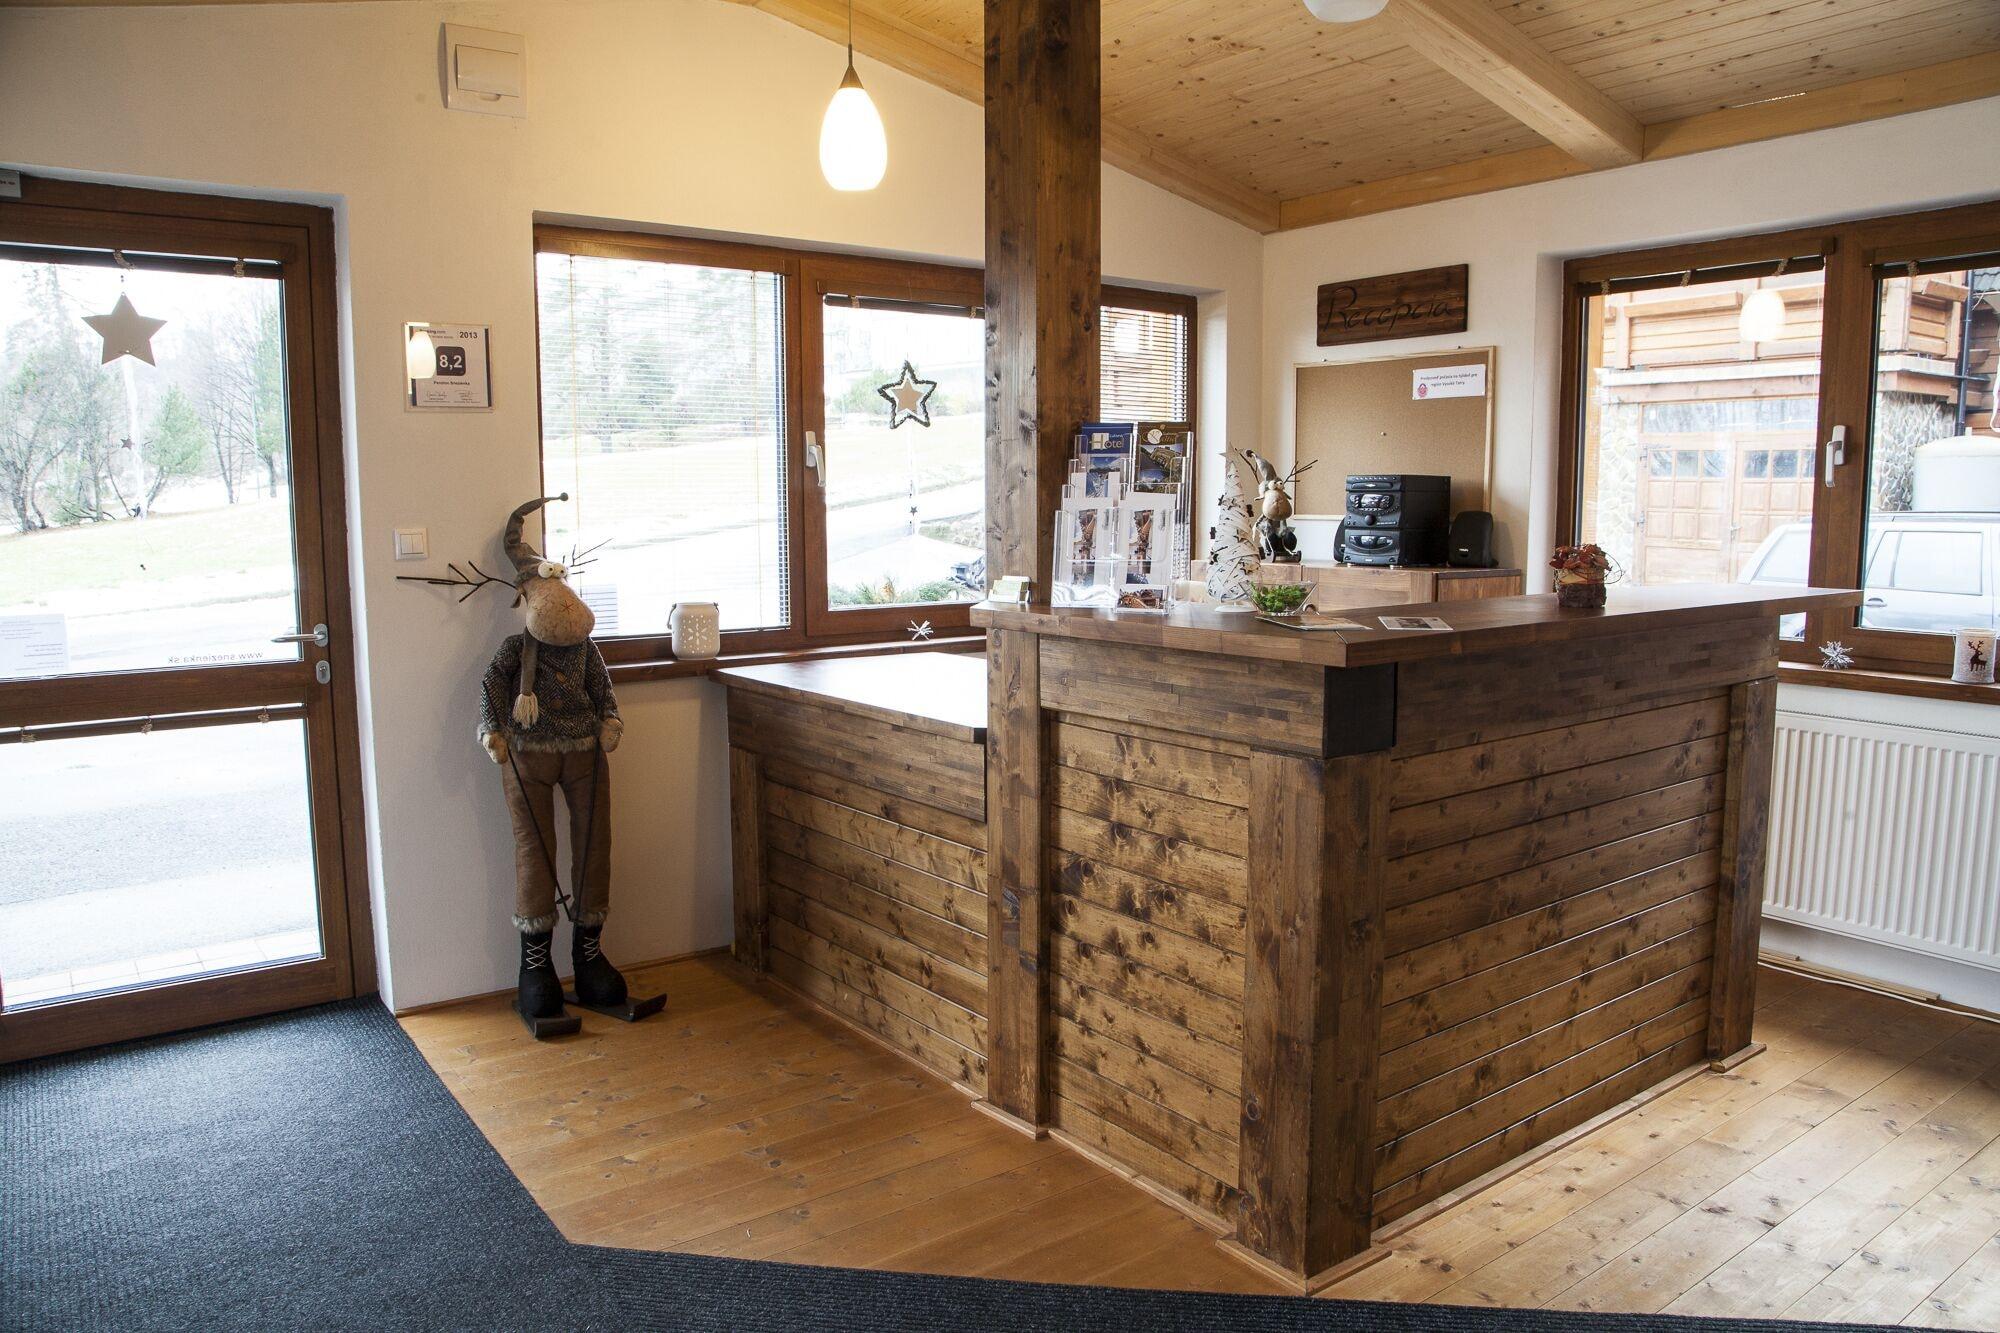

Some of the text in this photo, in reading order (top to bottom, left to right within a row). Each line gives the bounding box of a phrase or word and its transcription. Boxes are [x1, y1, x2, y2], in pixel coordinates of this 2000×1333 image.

[1323, 286, 1451, 332] Recepcia
[459, 331, 478, 339] 2013
[439, 354, 463, 370] 8,2
